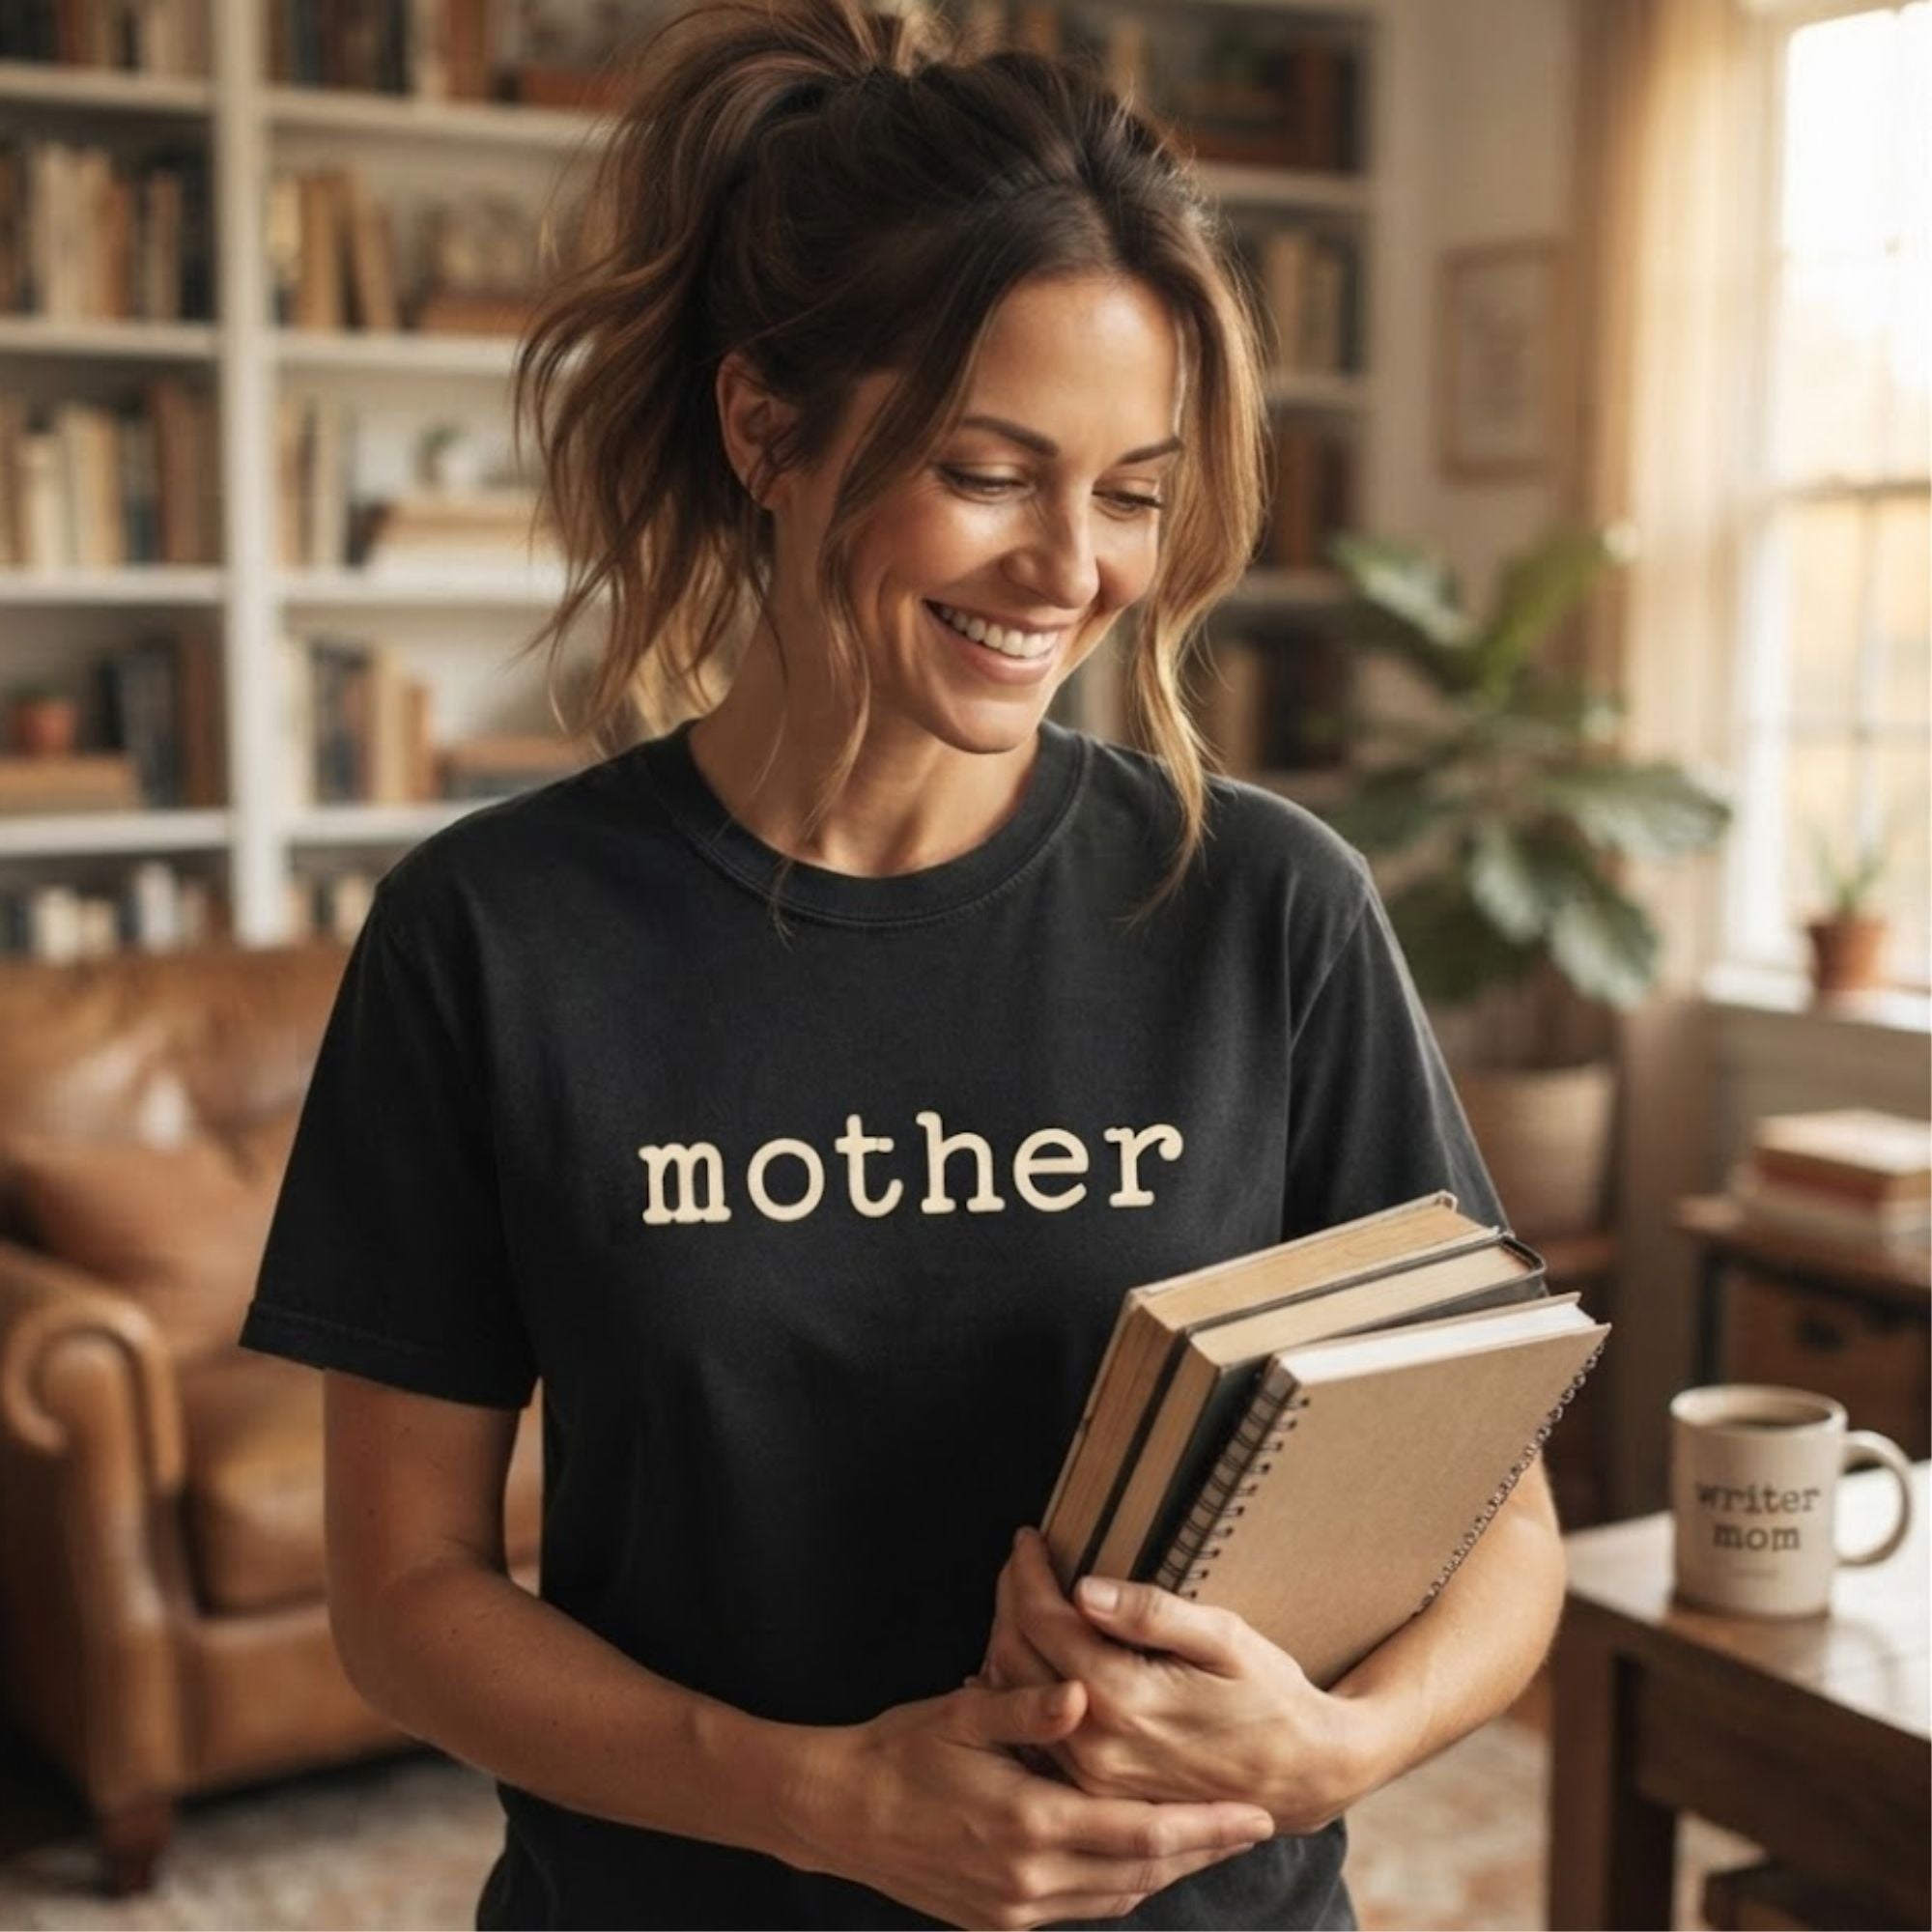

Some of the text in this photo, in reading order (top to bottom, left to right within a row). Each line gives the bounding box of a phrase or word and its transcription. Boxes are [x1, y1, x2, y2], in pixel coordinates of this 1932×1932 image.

[638, 1111, 1183, 1224] mother
[1697, 1485, 1820, 1514] writer
[1714, 1526, 1800, 1551] mom
